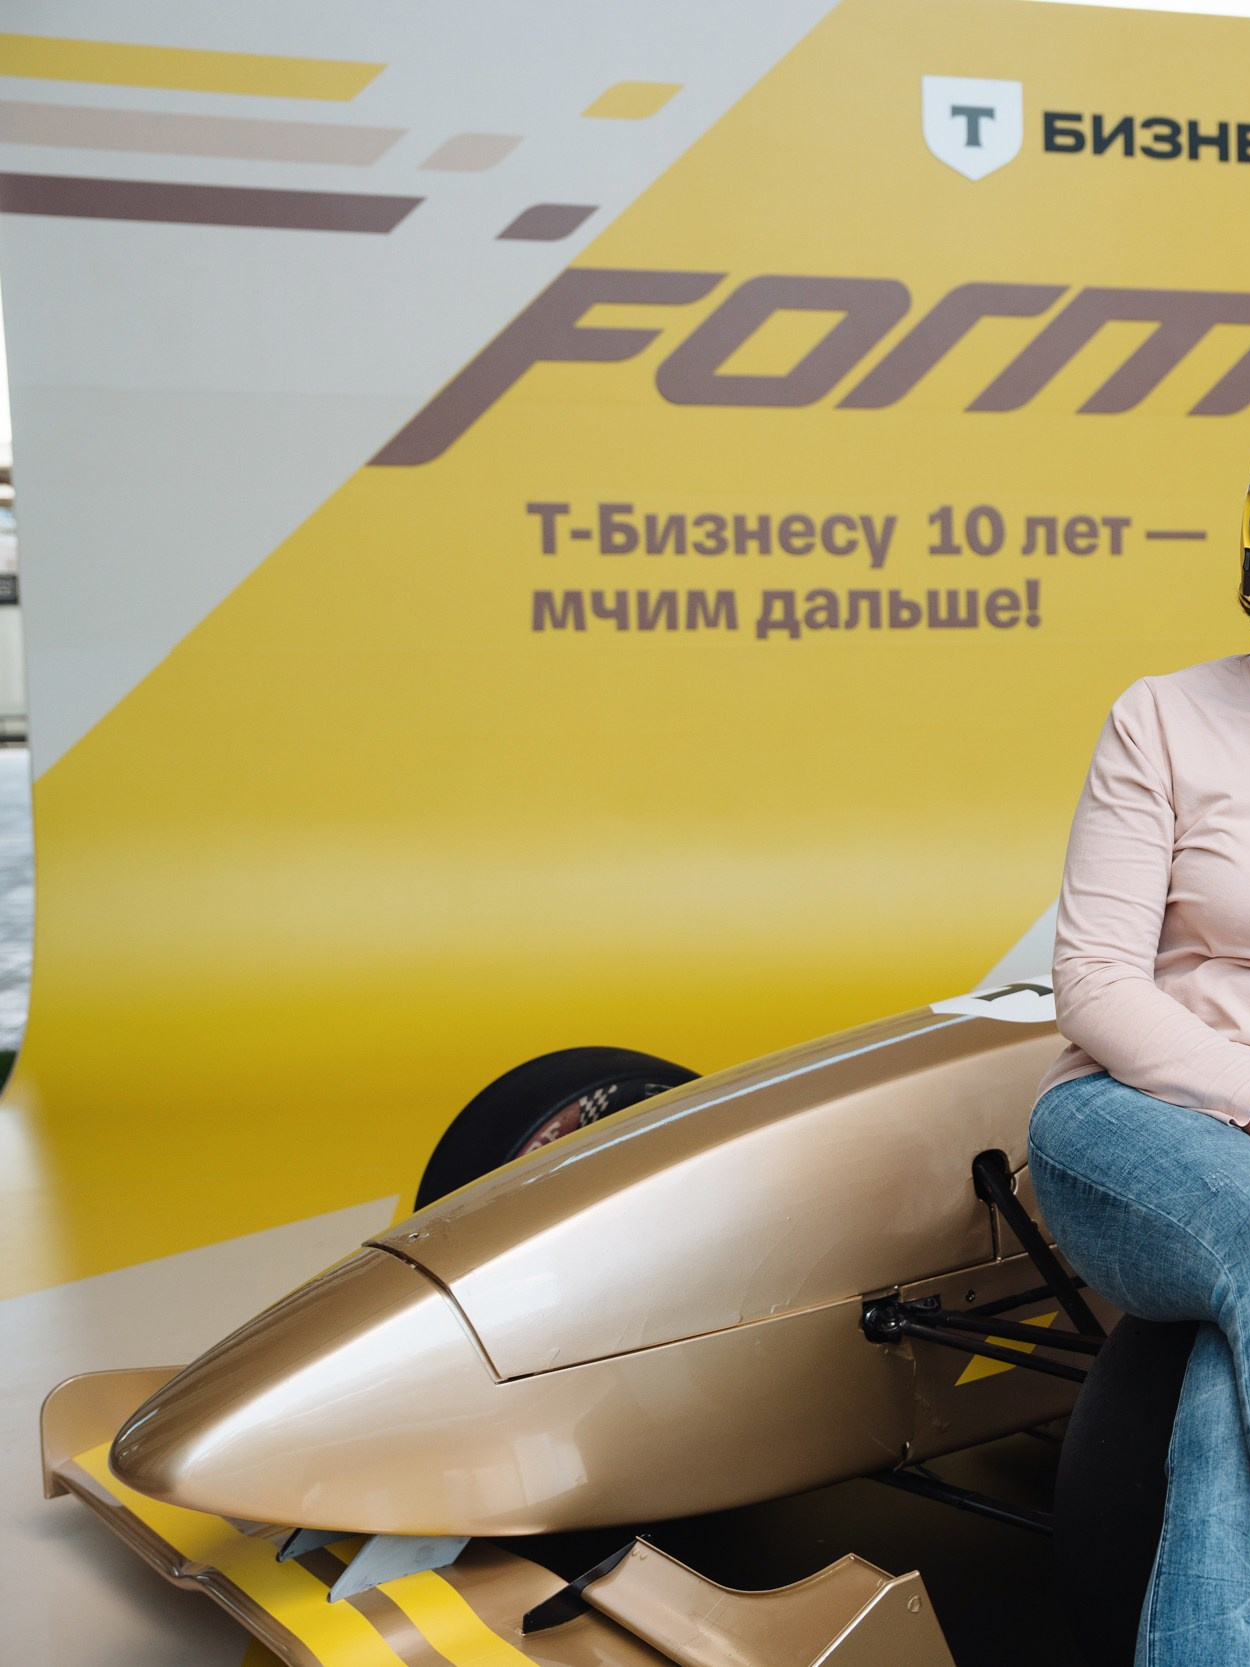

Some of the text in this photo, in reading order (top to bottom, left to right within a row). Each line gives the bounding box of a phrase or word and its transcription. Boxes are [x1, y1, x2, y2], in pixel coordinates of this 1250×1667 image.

[526, 501, 898, 569] Т-Бизнесу
[927, 505, 1005, 556] 10
[1020, 516, 1132, 557] лет
[531, 579, 1043, 640] мчим дальше!
